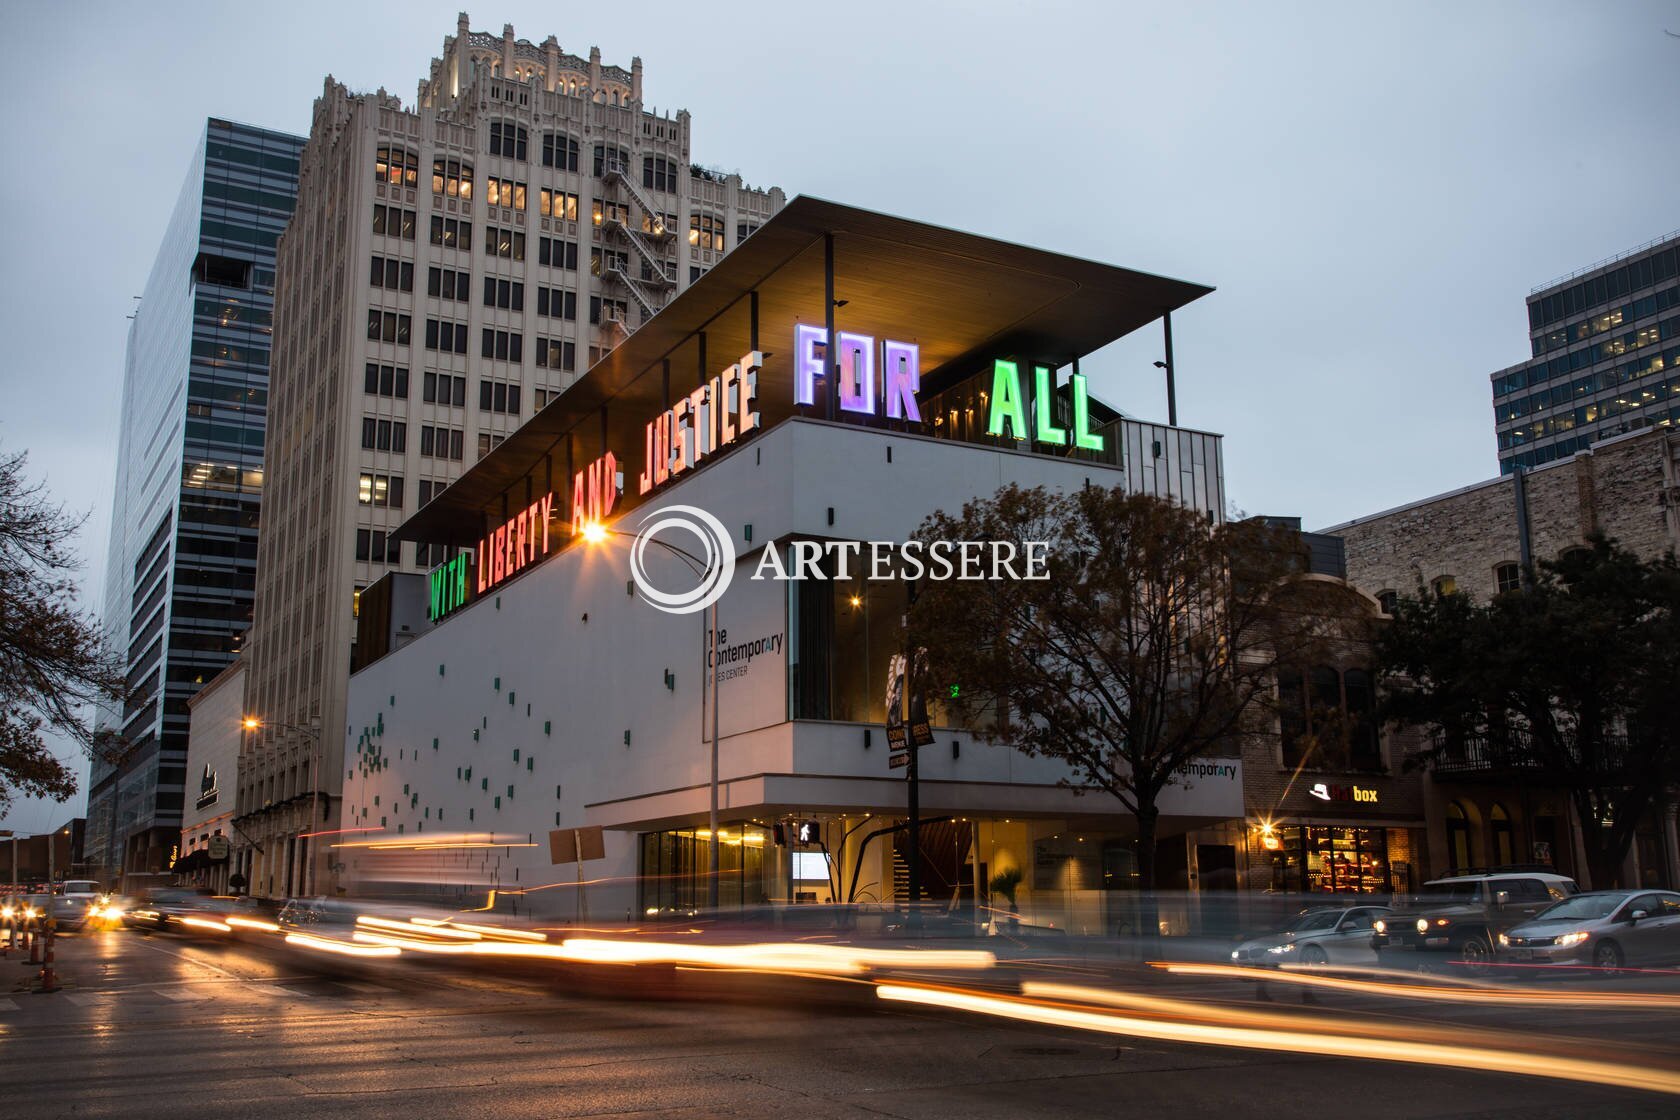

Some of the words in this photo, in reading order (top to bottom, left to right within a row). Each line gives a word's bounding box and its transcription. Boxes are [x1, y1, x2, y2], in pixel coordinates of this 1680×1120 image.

[431, 551, 470, 622] WITH
[477, 491, 554, 595] LIBERTY
[571, 450, 619, 536] AND
[640, 350, 763, 496] JUSTICE
[794, 323, 922, 422] FOR
[985, 358, 1104, 451] ALL
